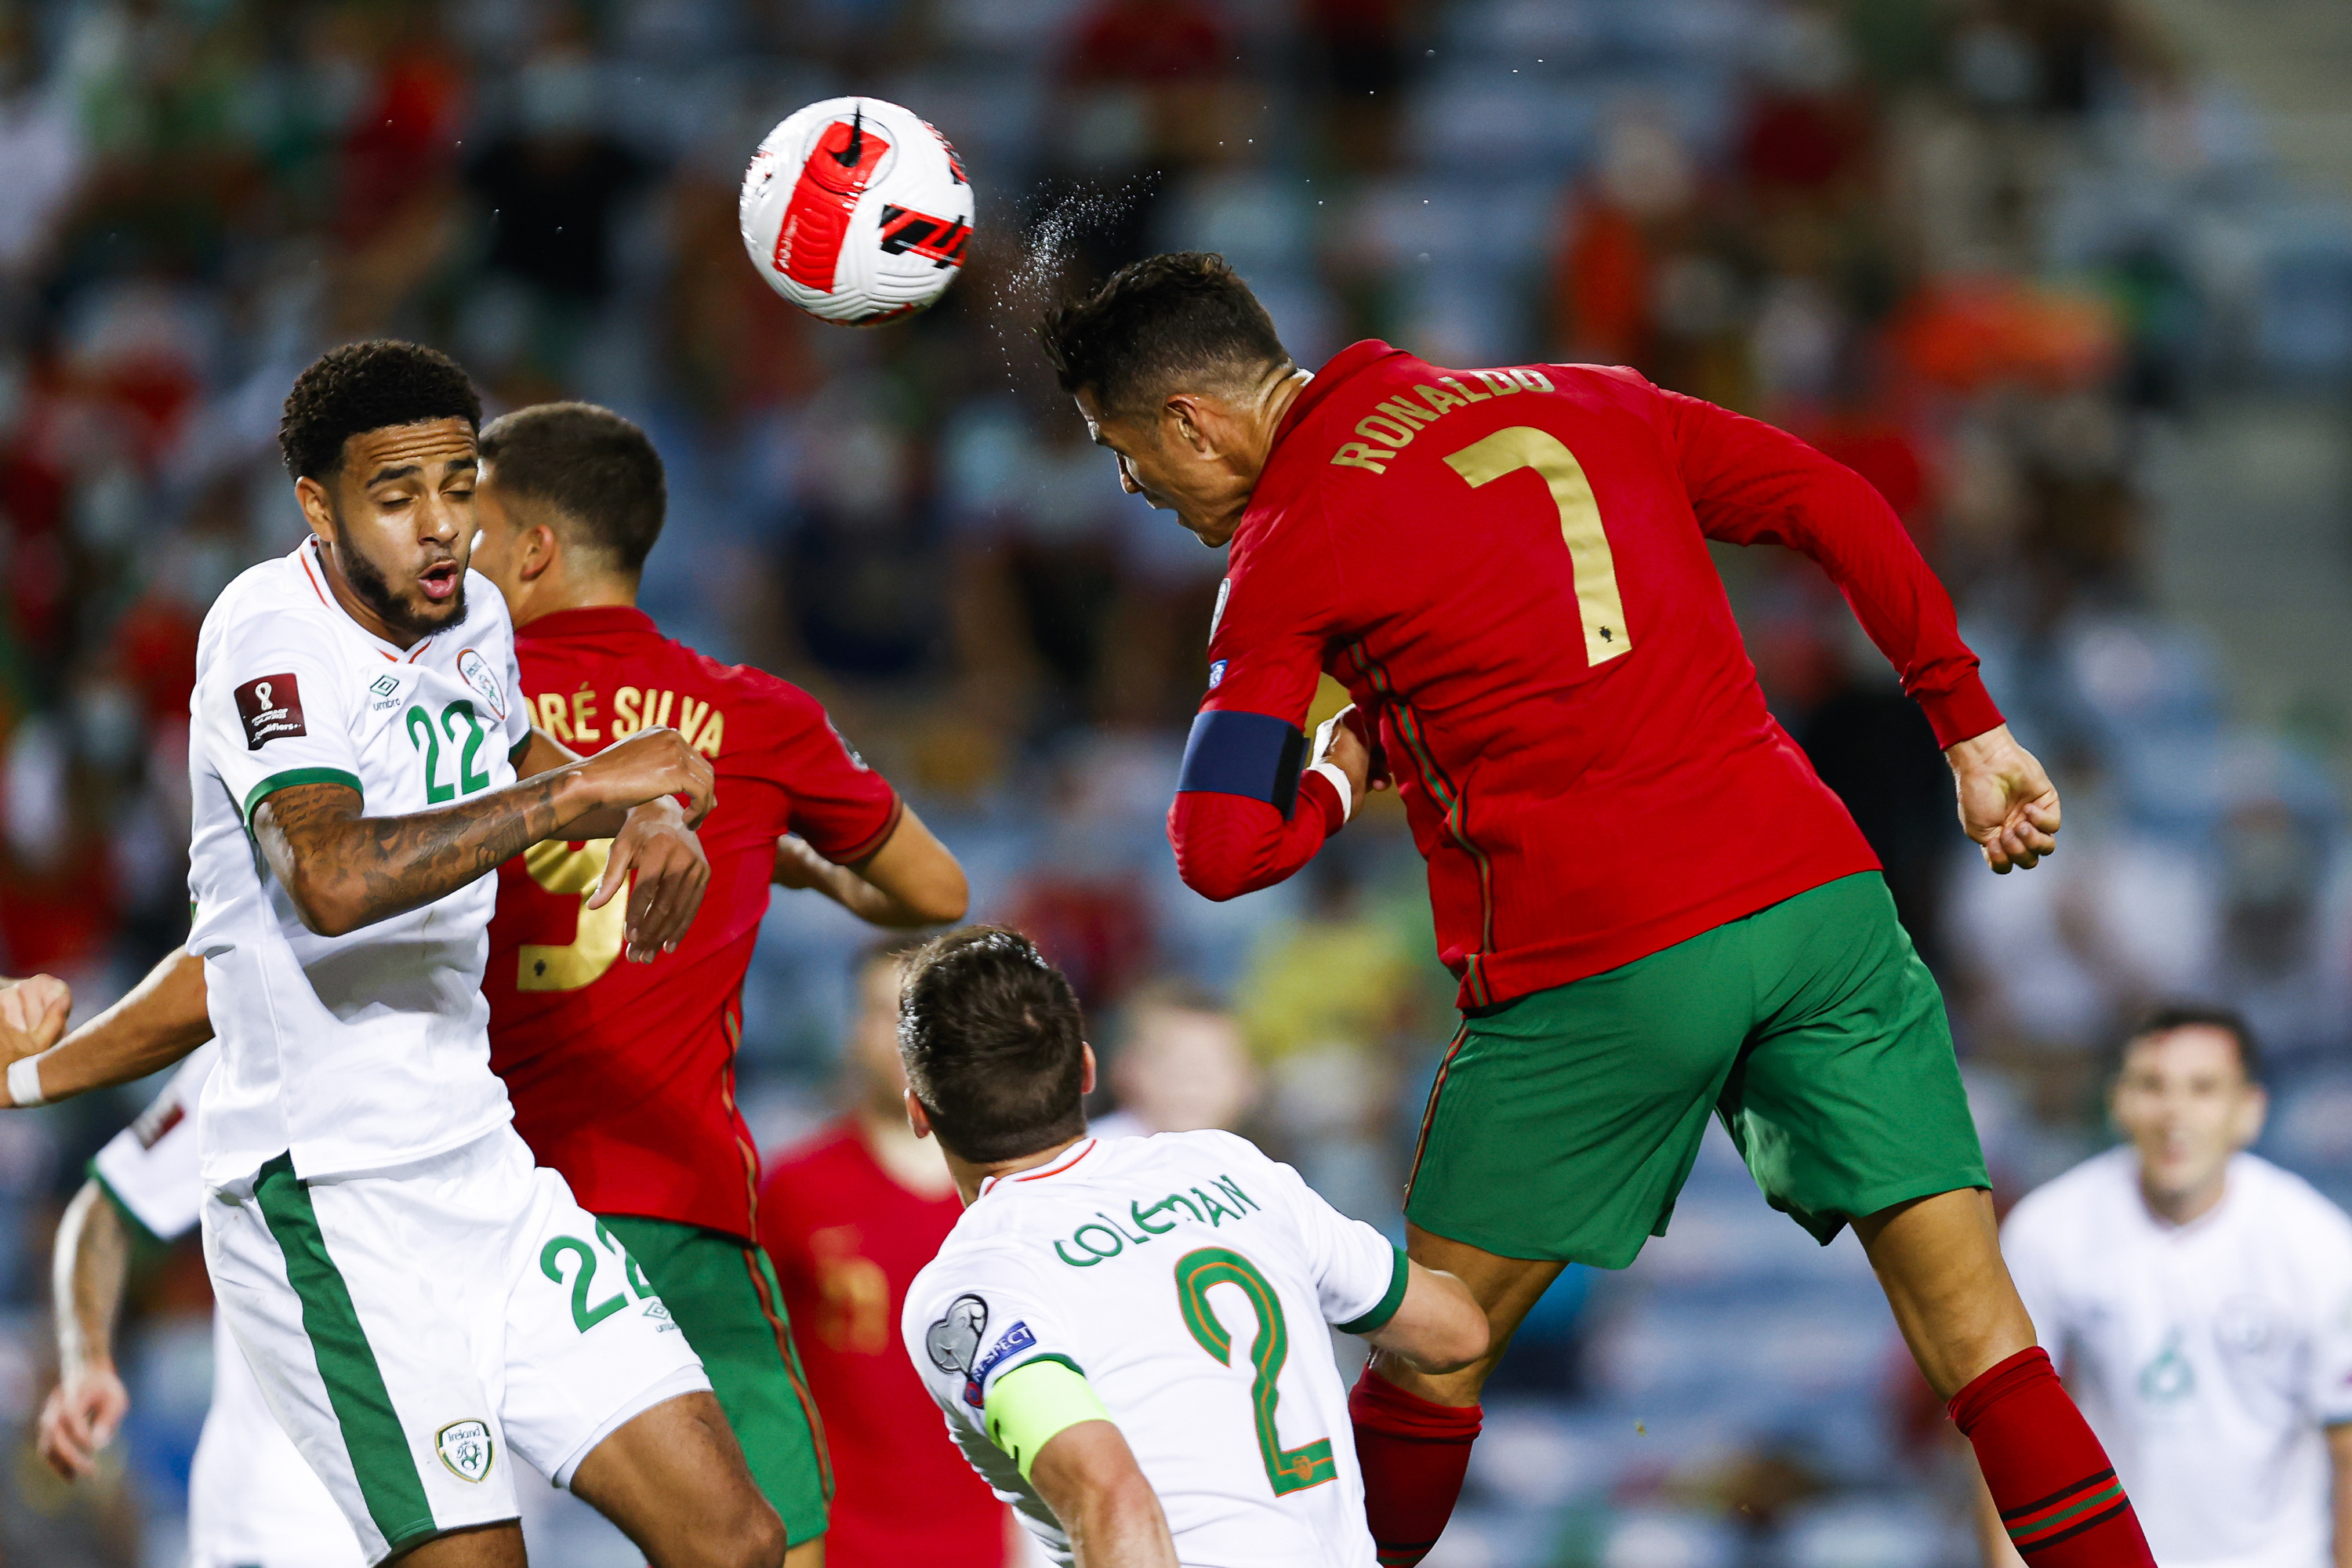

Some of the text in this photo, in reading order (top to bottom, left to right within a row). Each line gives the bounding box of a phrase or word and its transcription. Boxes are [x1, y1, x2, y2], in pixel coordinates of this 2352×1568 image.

[1330, 368, 1555, 474] RONALDO
[1443, 426, 1632, 667] 7
[373, 698, 401, 711] umbro
[406, 699, 489, 804] 22
[516, 837, 630, 993] 9
[1054, 1174, 1261, 1267] COLEMAN
[1174, 1246, 1338, 1497] 2
[447, 1426, 481, 1442] Ireland
